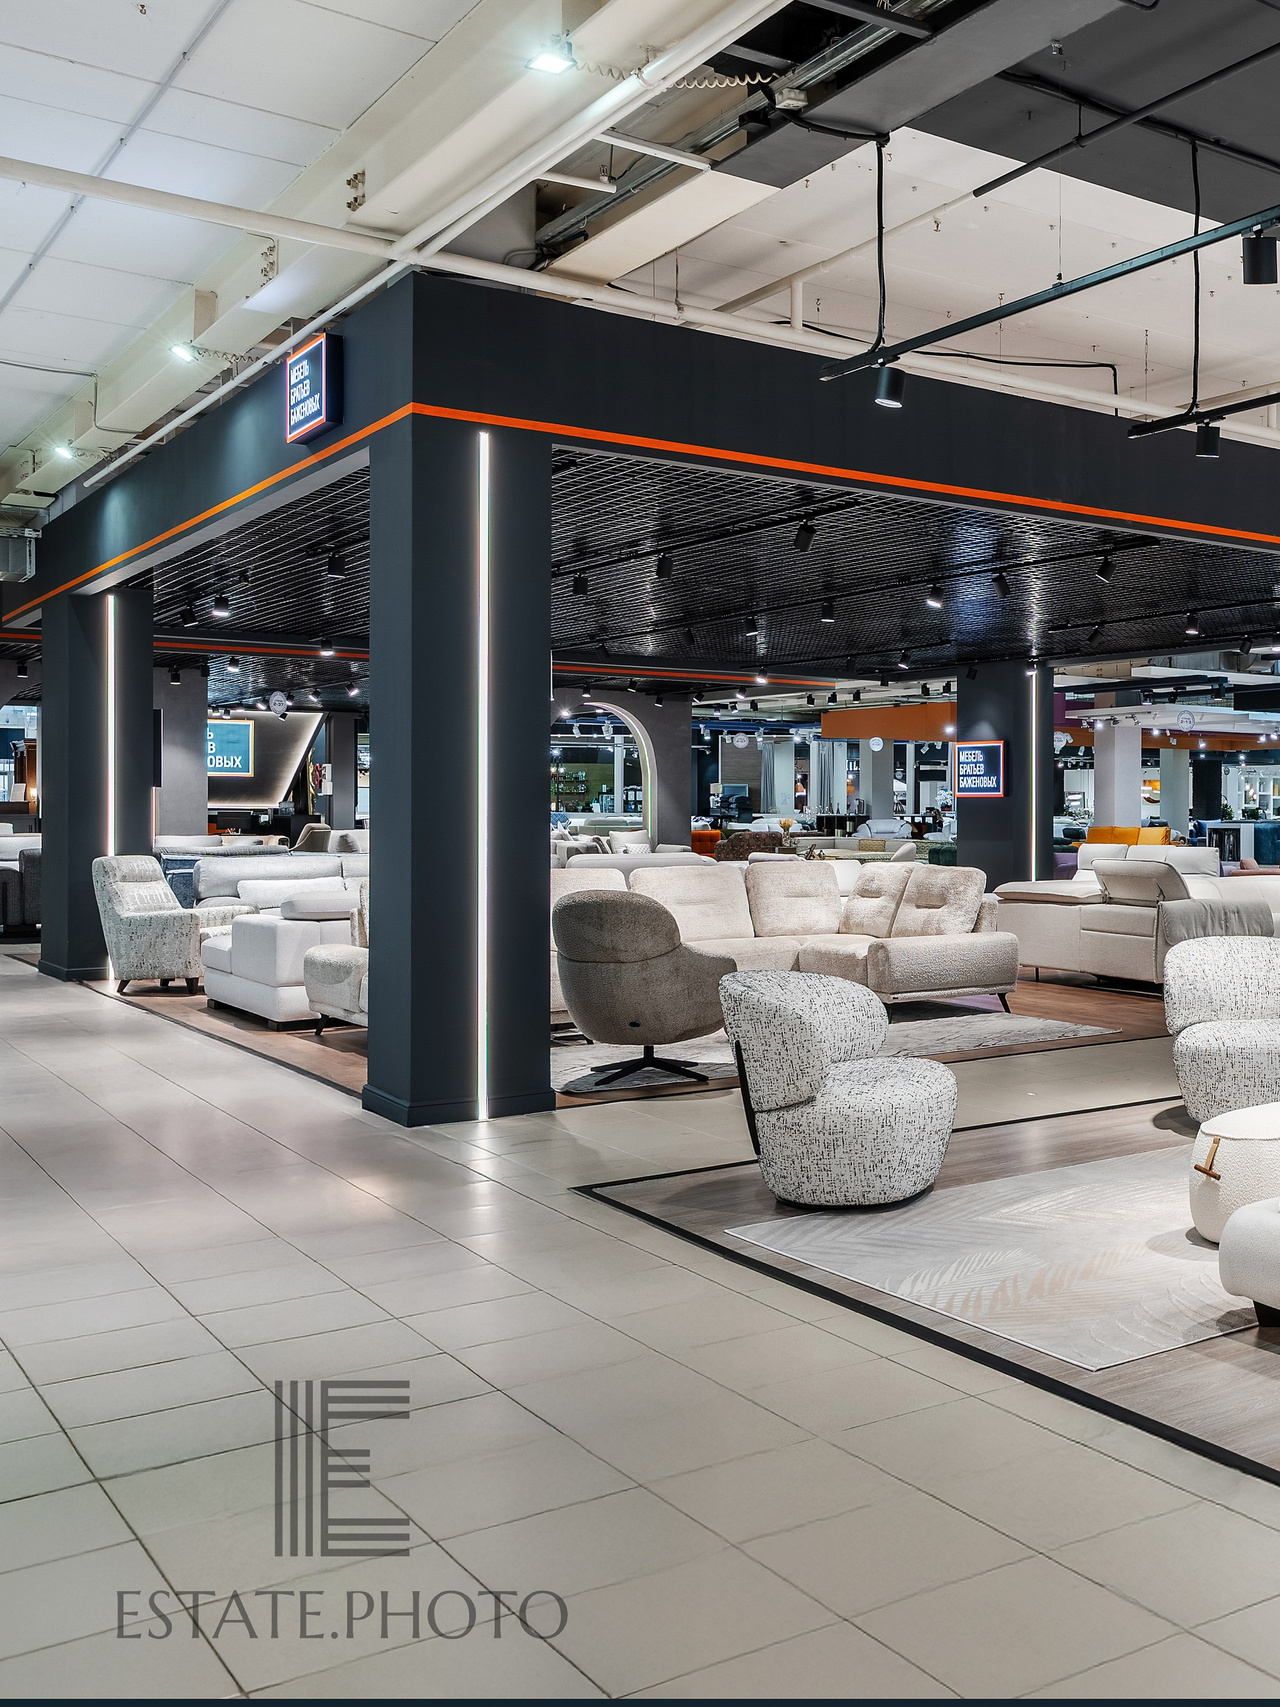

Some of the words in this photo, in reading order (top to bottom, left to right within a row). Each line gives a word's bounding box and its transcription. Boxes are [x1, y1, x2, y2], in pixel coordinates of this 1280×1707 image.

[290, 360, 309, 385] МЕБЕЛЬ
[290, 379, 311, 406] БРАТЬЕВ
[290, 393, 321, 426] БАЖЕНОВЫХ
[960, 750, 983, 762] МЕБЕЛЬ
[960, 763, 985, 775] БРАТЬЕВ
[960, 776, 997, 788] БАЖЕНОВЫХ
